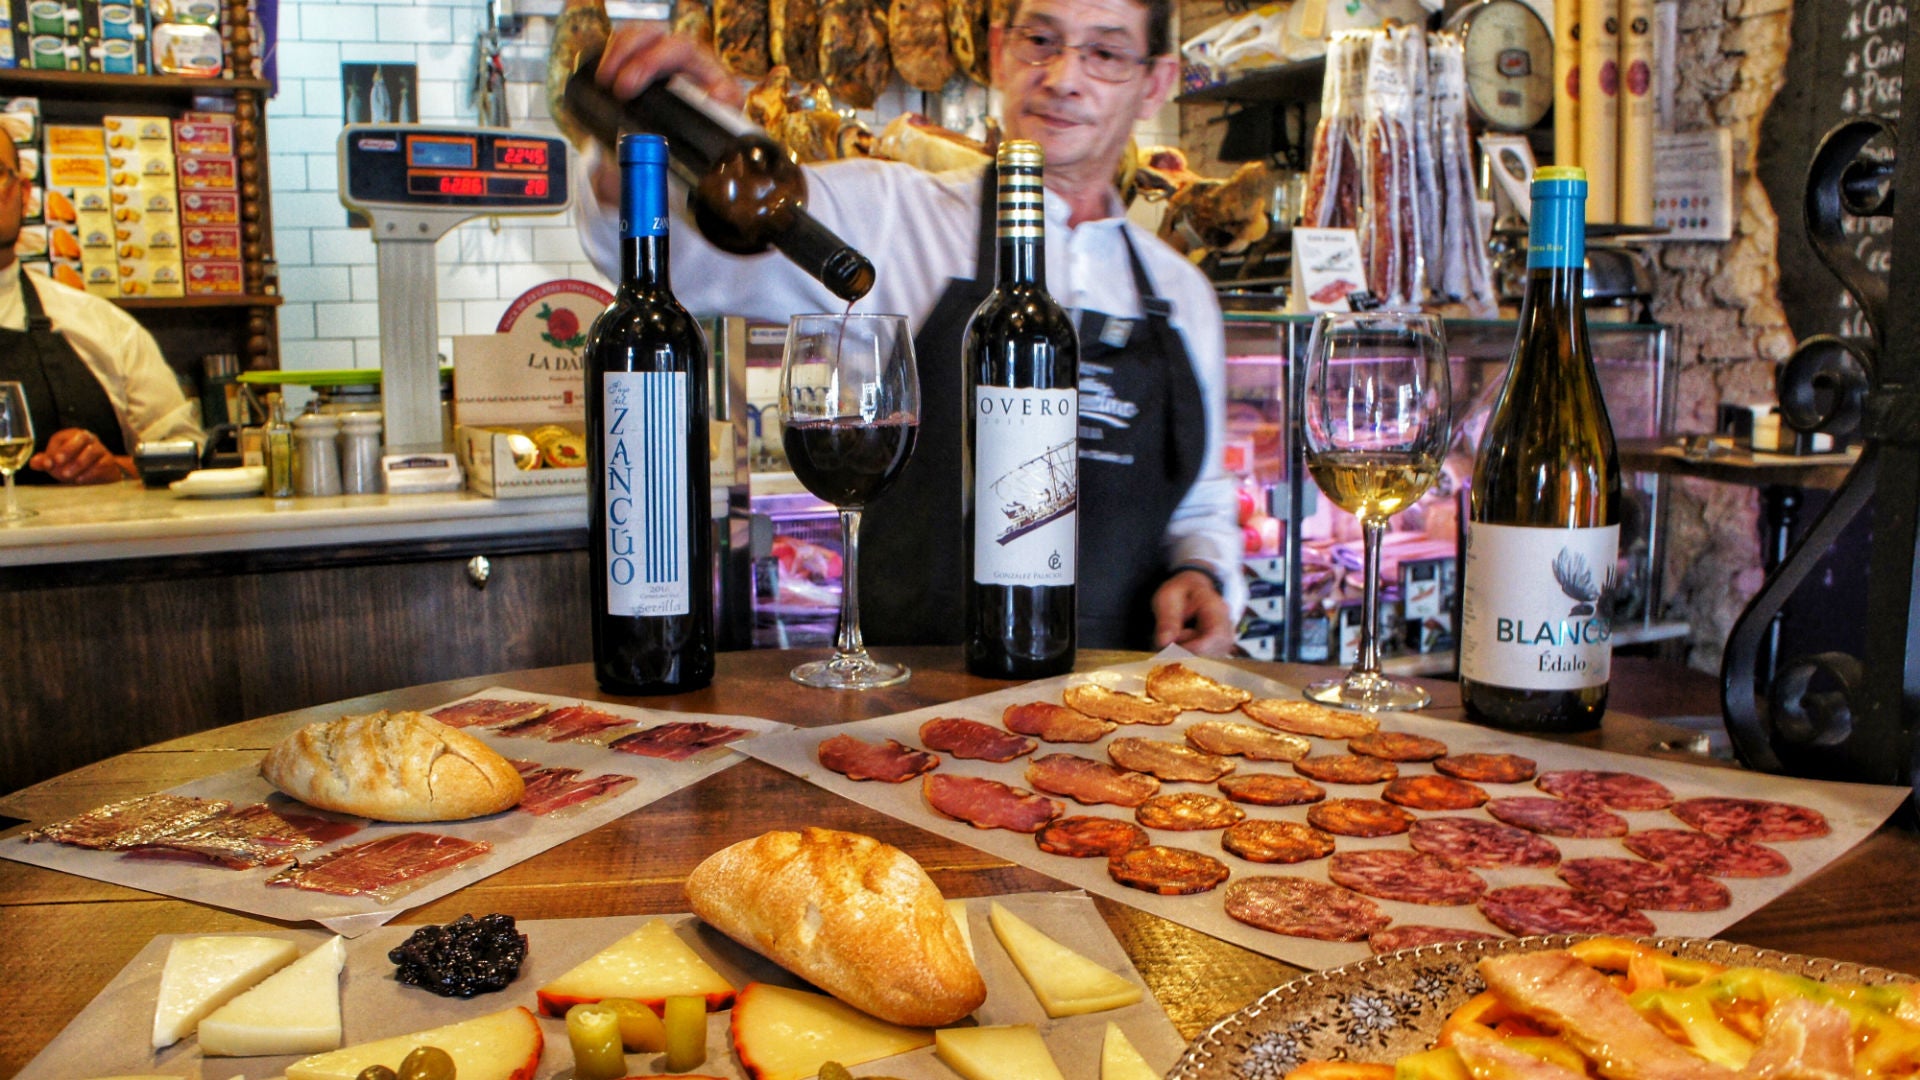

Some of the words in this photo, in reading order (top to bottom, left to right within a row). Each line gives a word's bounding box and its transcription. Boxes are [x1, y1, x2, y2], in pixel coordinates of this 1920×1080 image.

[528, 353, 550, 370] LA
[555, 356, 585, 370] DA
[980, 396, 1070, 416] OVERO
[609, 408, 635, 586] ZANCÚO
[1497, 617, 1612, 646] BLANCO
[1538, 650, 1587, 672] Édalo
